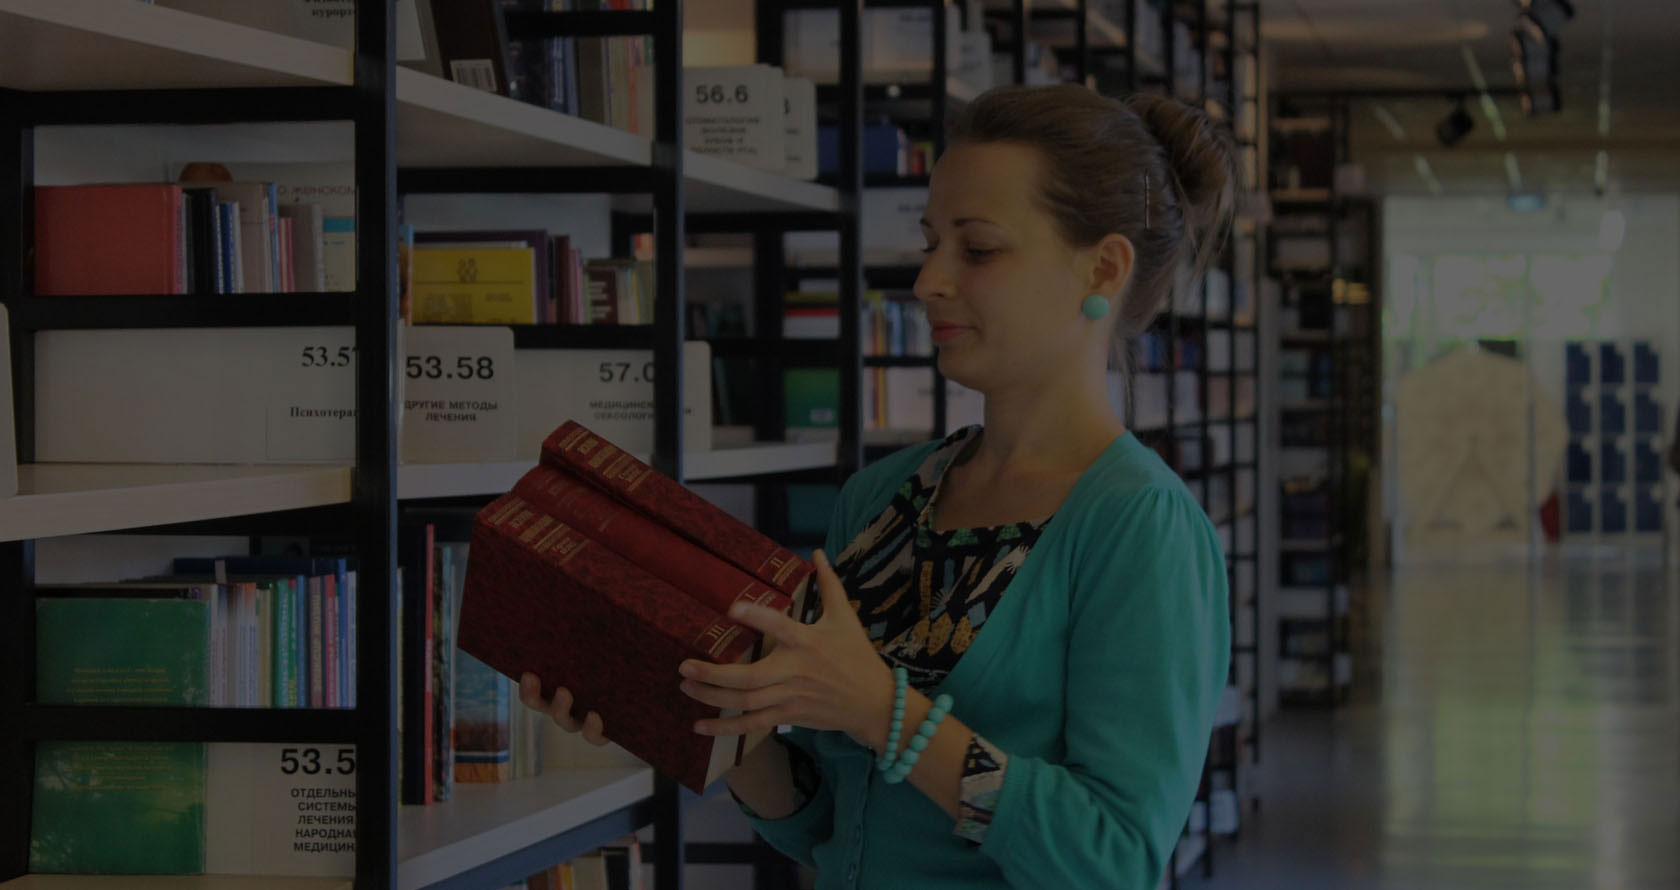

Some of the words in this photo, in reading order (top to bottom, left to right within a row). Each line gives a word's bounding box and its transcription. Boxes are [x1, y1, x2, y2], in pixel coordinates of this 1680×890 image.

[695, 84, 749, 106] 56.6
[302, 346, 358, 367] 53.5
[406, 355, 494, 379] 53.58
[448, 400, 499, 411] МЕТОДЫ
[425, 412, 477, 422] ЛЕЧЕНИЯ
[280, 748, 356, 775] 53.5
[297, 815, 354, 825] ЛЕЧЕНИЯ
[293, 842, 356, 854] МЕДИЦИН
